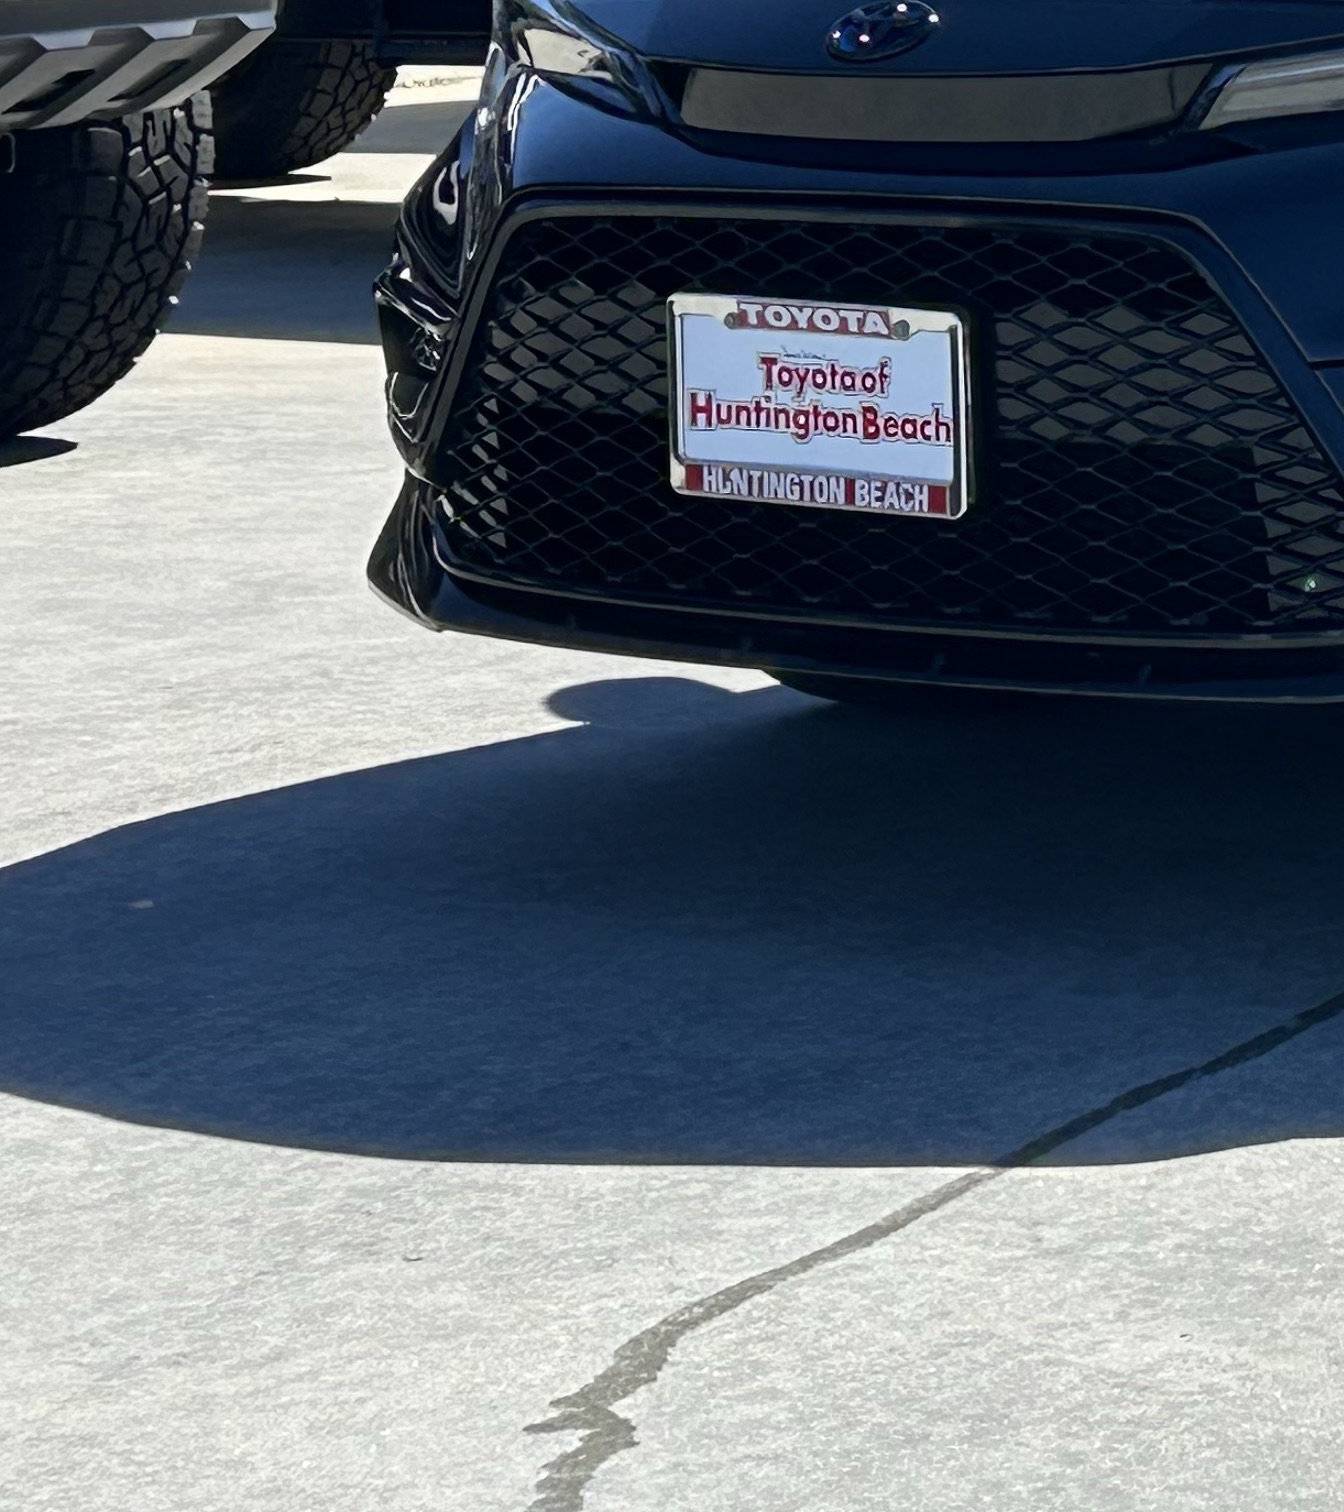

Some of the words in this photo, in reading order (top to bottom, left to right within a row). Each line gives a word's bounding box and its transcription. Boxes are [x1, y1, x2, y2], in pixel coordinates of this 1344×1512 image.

[738, 303, 890, 336] TOYOTA
[759, 355, 856, 399] Toyota
[860, 359, 890, 392] of
[688, 391, 858, 441] Huntington
[860, 404, 952, 443] Beach
[854, 478, 930, 513] BEACH
